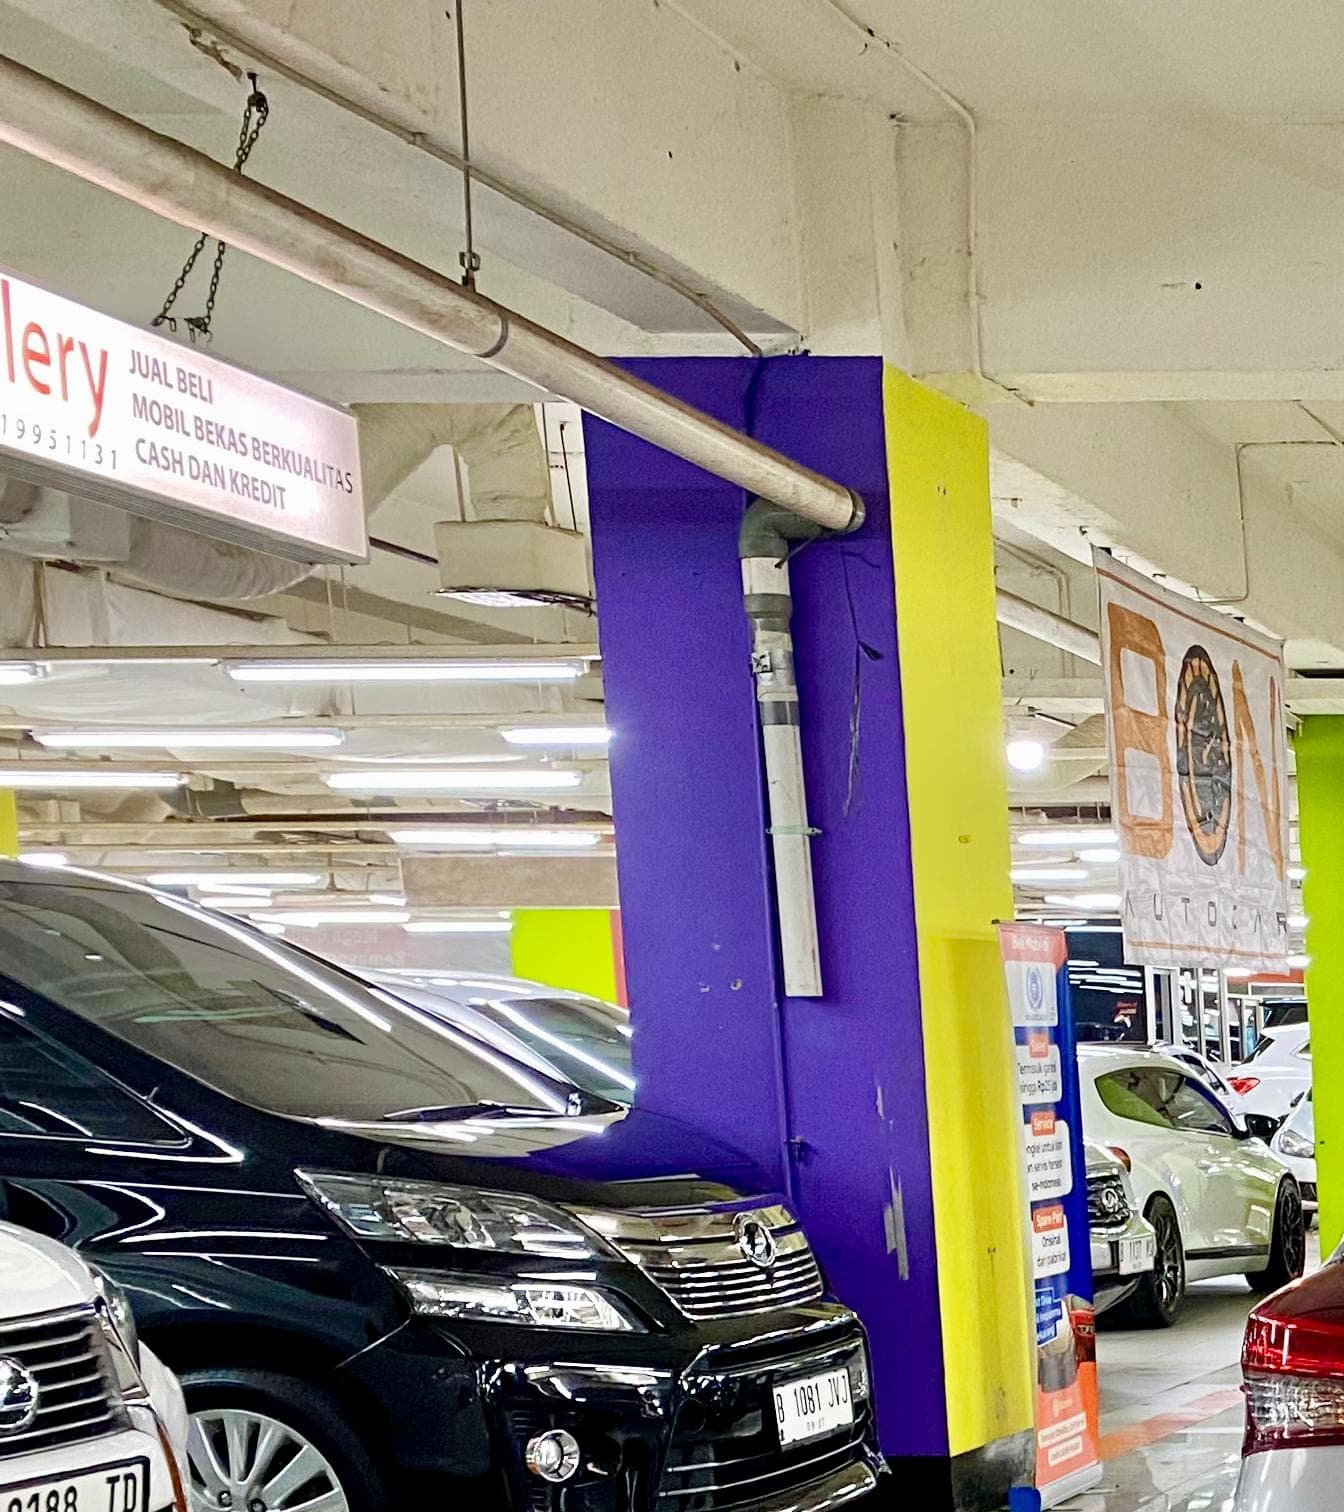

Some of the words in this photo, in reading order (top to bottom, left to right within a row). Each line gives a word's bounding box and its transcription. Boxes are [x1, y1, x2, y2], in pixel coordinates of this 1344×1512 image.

[129, 349, 173, 390] JUAL
[177, 372, 213, 404] BELI
[133, 392, 191, 438] MOBIL
[194, 414, 248, 457] BEKAS
[251, 436, 353, 494] BERKUALITAS
[135, 438, 184, 476] CASH
[188, 458, 226, 491] DAN
[229, 470, 286, 510] KREDIT
[794, 1382, 822, 1417] 1081
